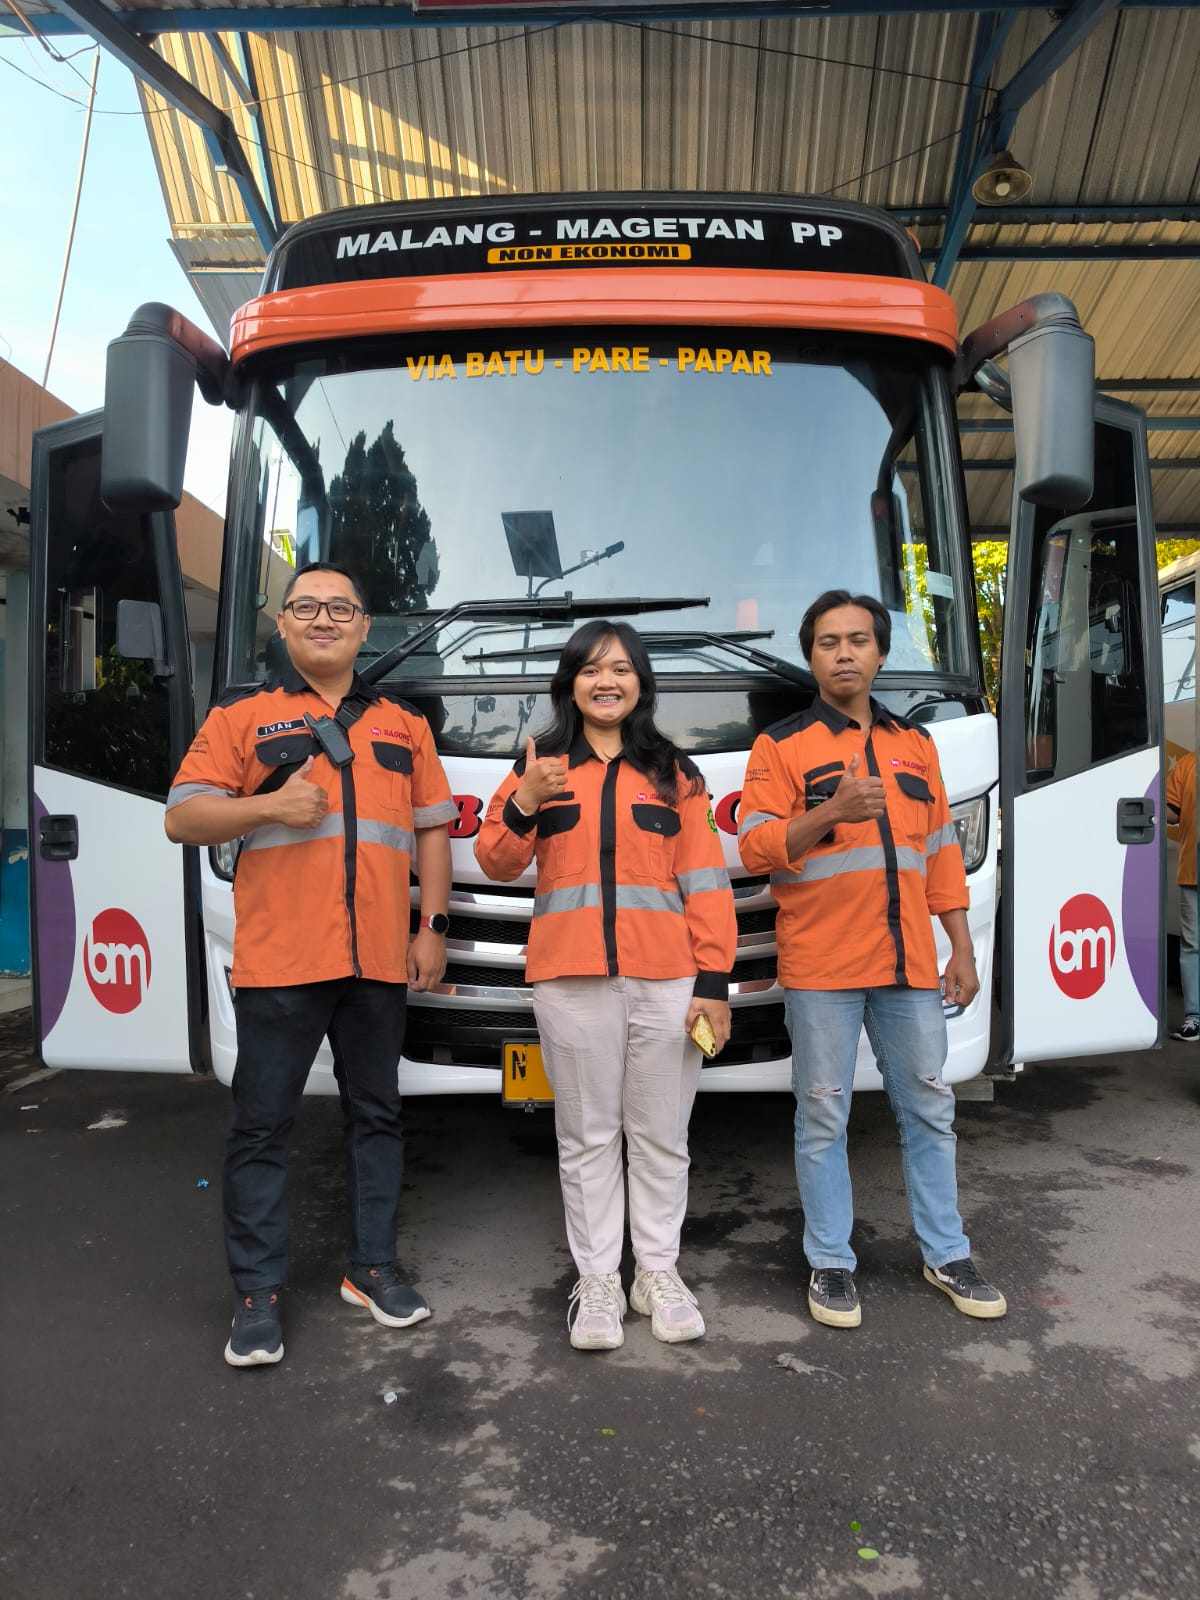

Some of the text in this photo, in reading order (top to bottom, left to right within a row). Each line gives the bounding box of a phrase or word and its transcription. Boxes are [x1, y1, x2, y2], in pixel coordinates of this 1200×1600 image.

[337, 222, 516, 259] MALANG
[556, 217, 765, 241] MAGETAN
[791, 222, 843, 246] PP
[499, 245, 680, 261] NON EKONOMI
[406, 354, 457, 381] VIA
[466, 349, 544, 377] BATU
[573, 347, 650, 373] PARE
[678, 347, 773, 375] PAPAR
[264, 722, 292, 734] IVAN
[512, 1050, 526, 1080] N
